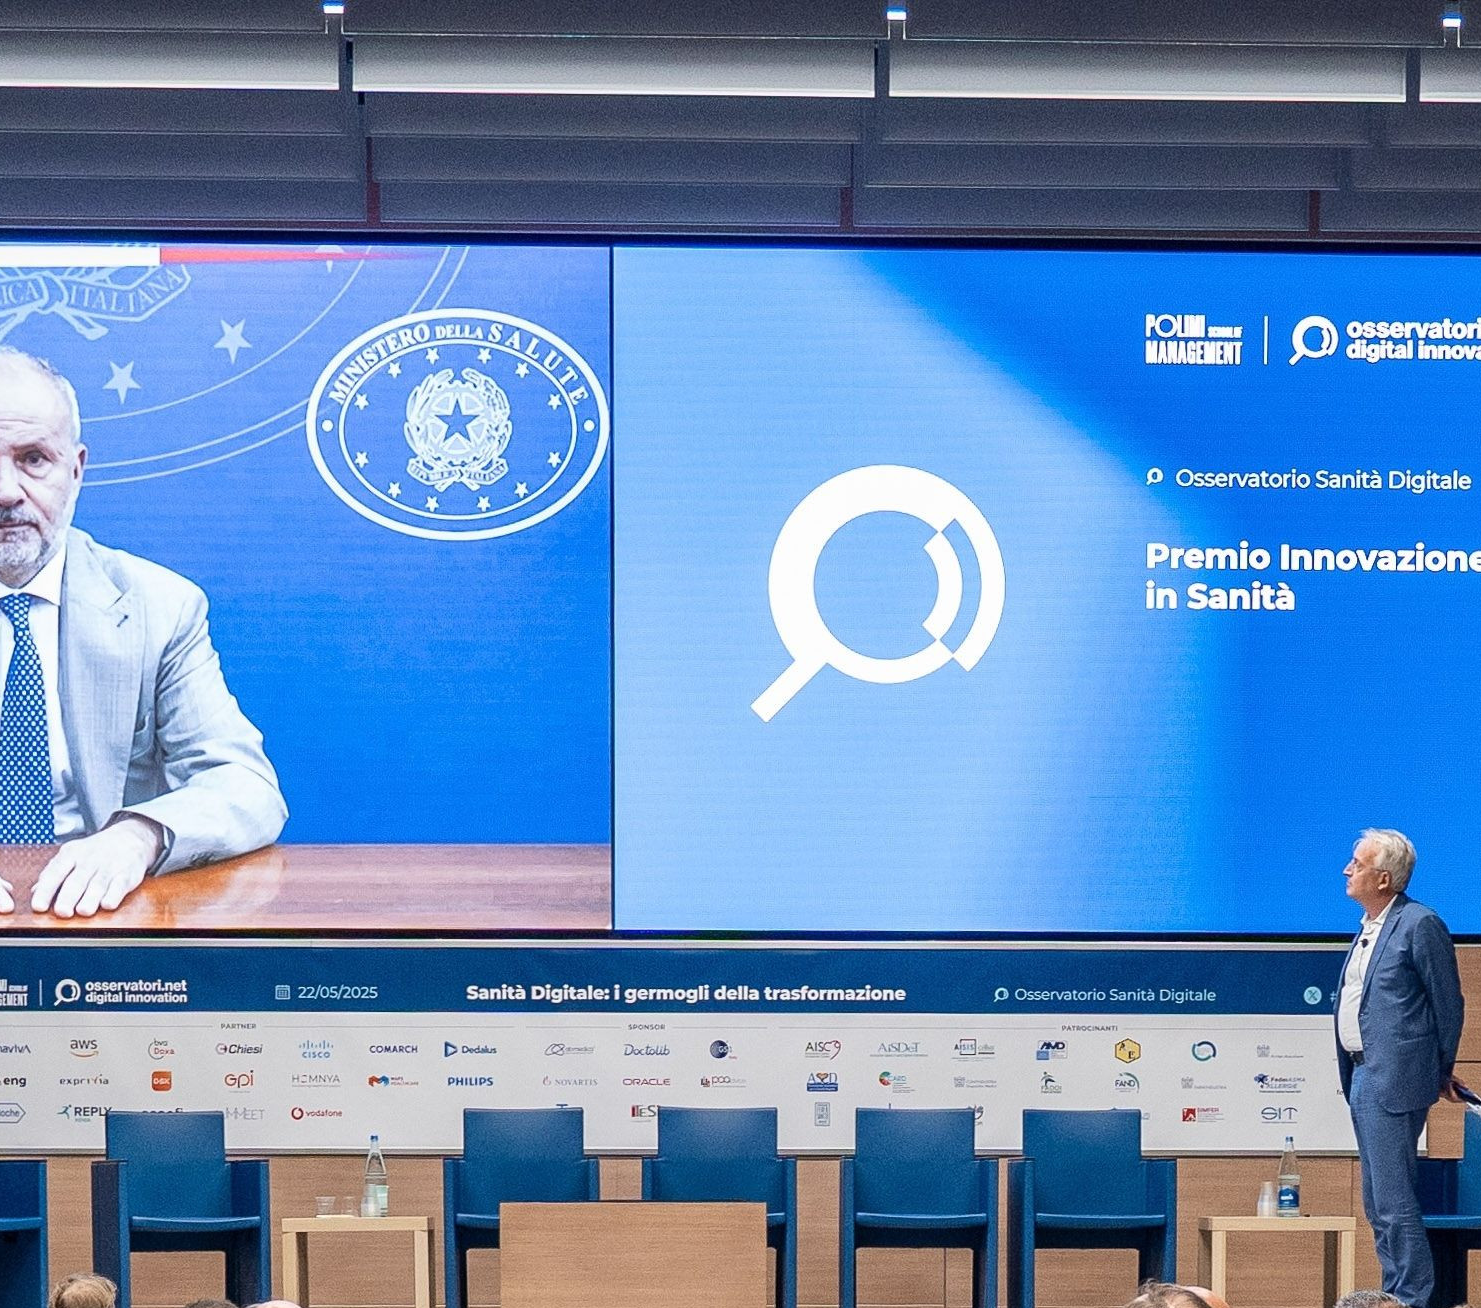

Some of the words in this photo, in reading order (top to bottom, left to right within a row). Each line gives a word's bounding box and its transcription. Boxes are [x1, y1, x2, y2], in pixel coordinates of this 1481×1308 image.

[71, 267, 184, 313] ITALIANA
[1145, 341, 1243, 365] MANAGEMENT
[1346, 339, 1413, 363] digital
[328, 323, 430, 405] MINISTERO
[435, 323, 484, 341] DELLA
[488, 323, 591, 405] SALUTE
[1175, 468, 1311, 490] Osservatorio
[1315, 468, 1383, 490] Sanità
[1388, 469, 1472, 494] Digitale
[1146, 541, 1272, 572] Premio
[1146, 580, 1178, 611] in
[1187, 580, 1297, 612] Sanità
[85, 979, 187, 992] osservatori.net
[298, 984, 378, 1000] 22/05/2025
[85, 991, 122, 1004] digital
[125, 991, 188, 1003] innovation
[466, 984, 526, 1000] Sanità
[531, 984, 610, 1003] Digitale:
[614, 984, 620, 1000] i
[624, 984, 710, 1003] germogli
[714, 985, 759, 1000] della
[764, 984, 906, 1001] trasformazione
[1015, 988, 1106, 1001] Osservatorio
[1110, 988, 1155, 1001] Sanità
[1160, 988, 1216, 1004] Digitale
[70, 1040, 98, 1049] aws
[154, 1047, 175, 1055] Doxa
[228, 1043, 263, 1054] Chiesi
[369, 1045, 418, 1053] COMARCH
[462, 1045, 497, 1054] Dedalus
[624, 1043, 670, 1056] Doctolib
[3, 1076, 26, 1087] eng
[448, 1077, 493, 1086] PHILIPS
[555, 1078, 598, 1086] NOVARTIS
[623, 1078, 670, 1086] ORACLE
[74, 1107, 112, 1116] REPLY
[306, 1107, 343, 1118] vodafone
[1261, 1107, 1298, 1120] SIT
